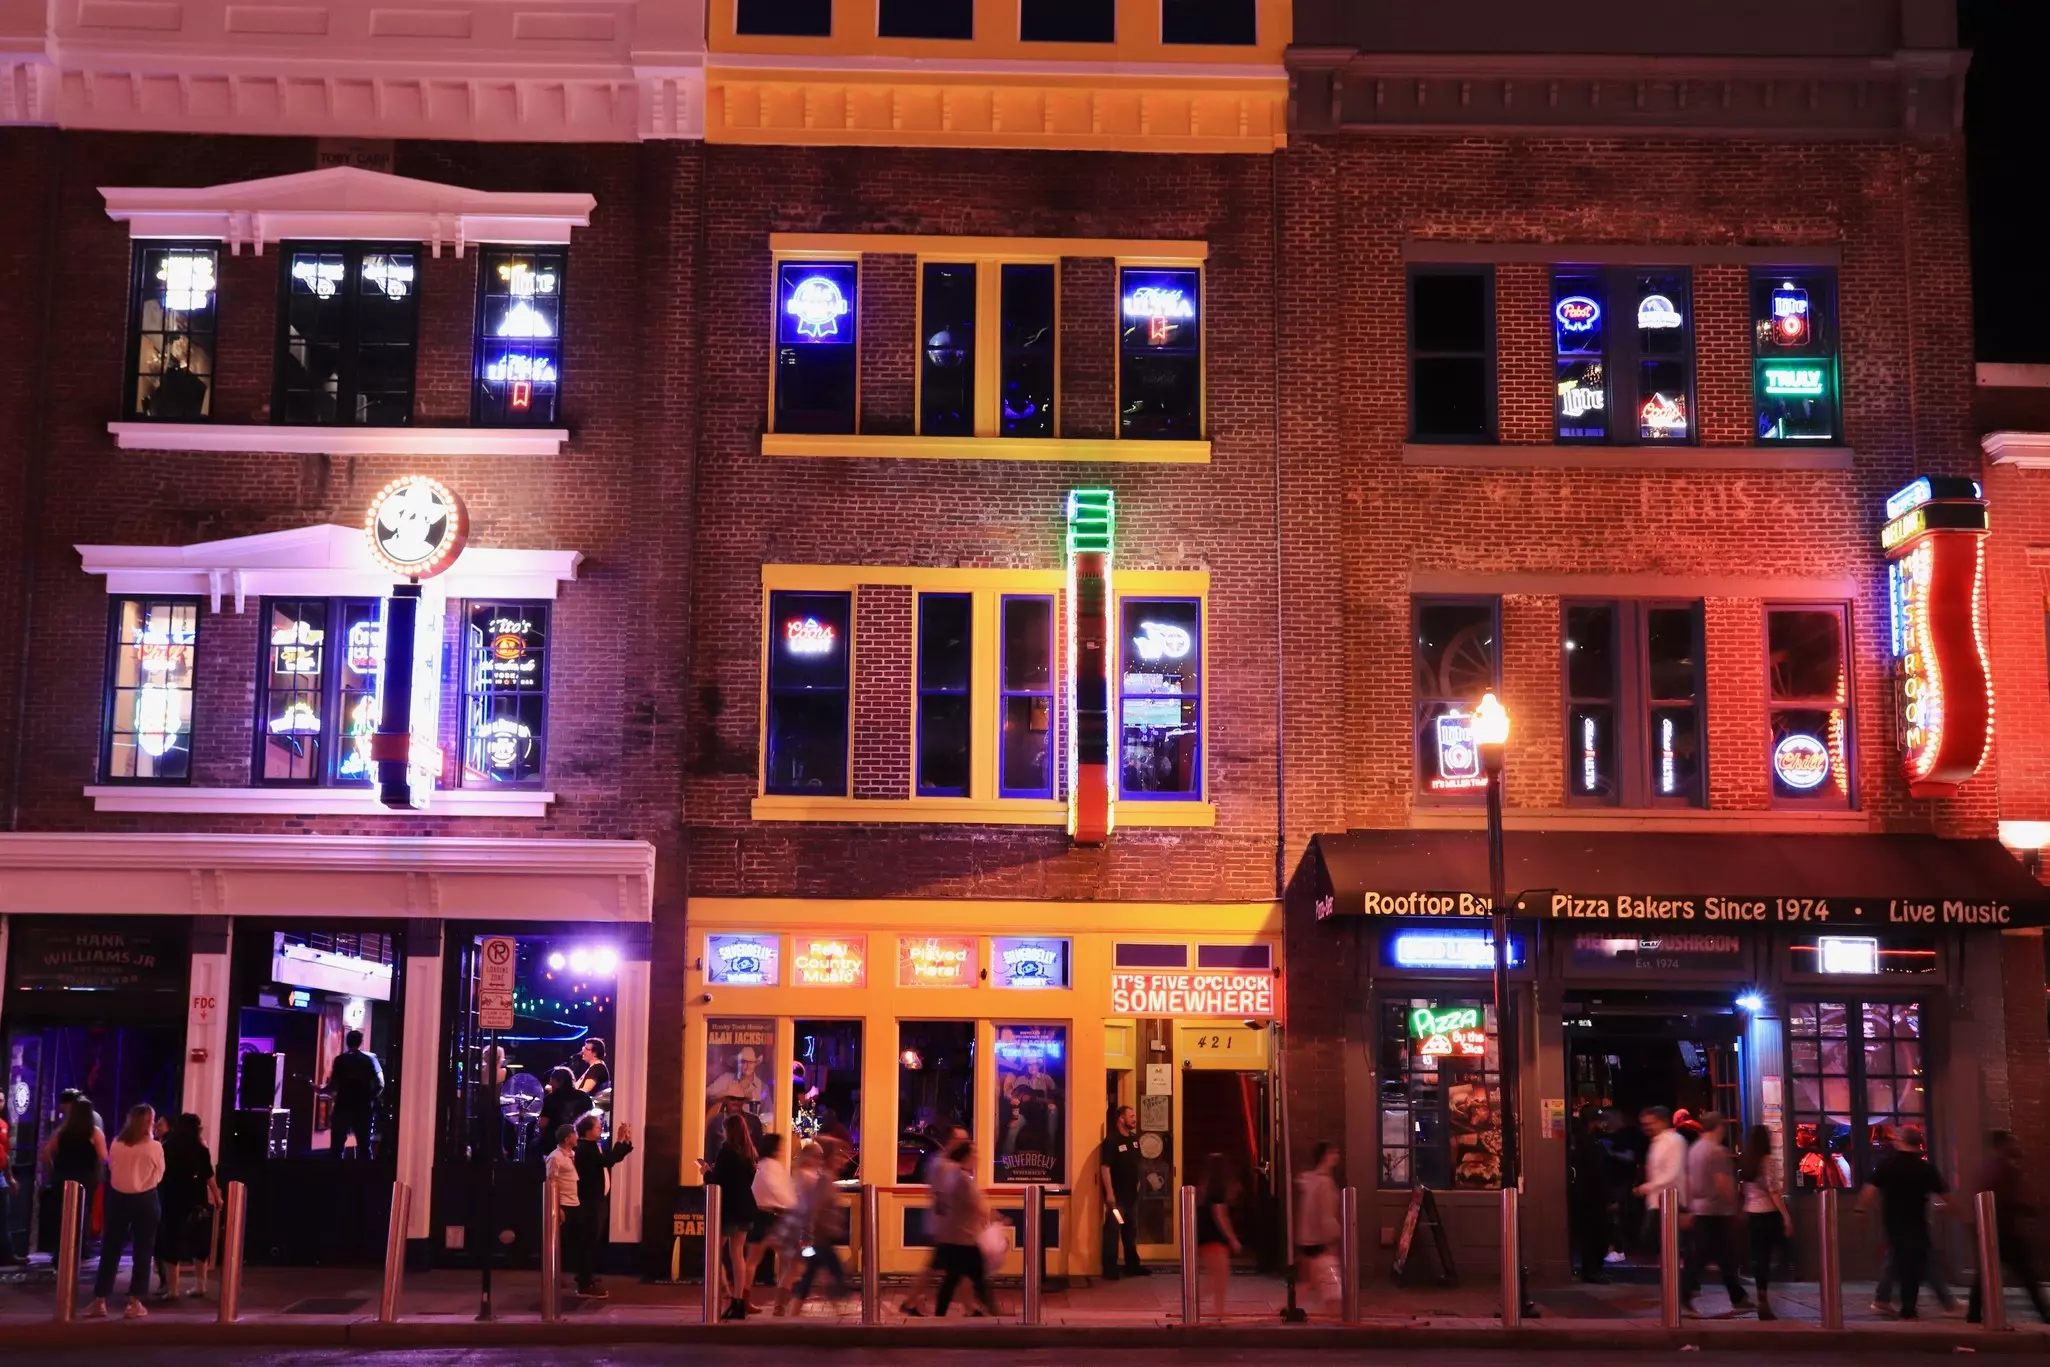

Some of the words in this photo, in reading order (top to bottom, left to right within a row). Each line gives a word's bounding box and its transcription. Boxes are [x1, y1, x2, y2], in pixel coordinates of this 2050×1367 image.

[1563, 304, 1592, 319] Pabst
[1765, 370, 1822, 388] TRULY
[1642, 402, 1681, 418] Coors
[489, 618, 532, 634] Tito's
[787, 621, 835, 639] Coors
[1899, 556, 1920, 748] MUSHROOM
[1778, 753, 1825, 770] Chill
[1365, 892, 1455, 915] Rooftop
[1551, 895, 1609, 918] Pizza
[1616, 895, 1695, 919] Bakers
[1704, 897, 1766, 921] Since
[1776, 899, 1830, 922] 1974
[1889, 901, 1936, 923] Live
[1943, 901, 2011, 925] Music
[76, 934, 126, 947] HANK
[43, 950, 131, 966] WILLIAMS
[133, 953, 157, 968] JR
[795, 955, 863, 970] Country
[910, 948, 967, 962] Played
[487, 966, 509, 974] LOADING
[915, 964, 960, 977] Here!
[1656, 959, 1680, 968] 1974
[491, 974, 505, 982] ZONE
[803, 970, 855, 982] Music
[1113, 975, 1145, 990] IT'S
[1152, 975, 1190, 990] FIVE
[1194, 976, 1269, 991] O'CLOCK
[194, 997, 215, 1009] FDC
[1114, 990, 1270, 1013] SOMEWHERE
[709, 1031, 733, 1044] ALAN
[734, 1031, 774, 1045] JACKSON
[1452, 1031, 1466, 1045] By
[1467, 1031, 1485, 1043] the
[1002, 1153, 1057, 1170] SILVERBELLY
